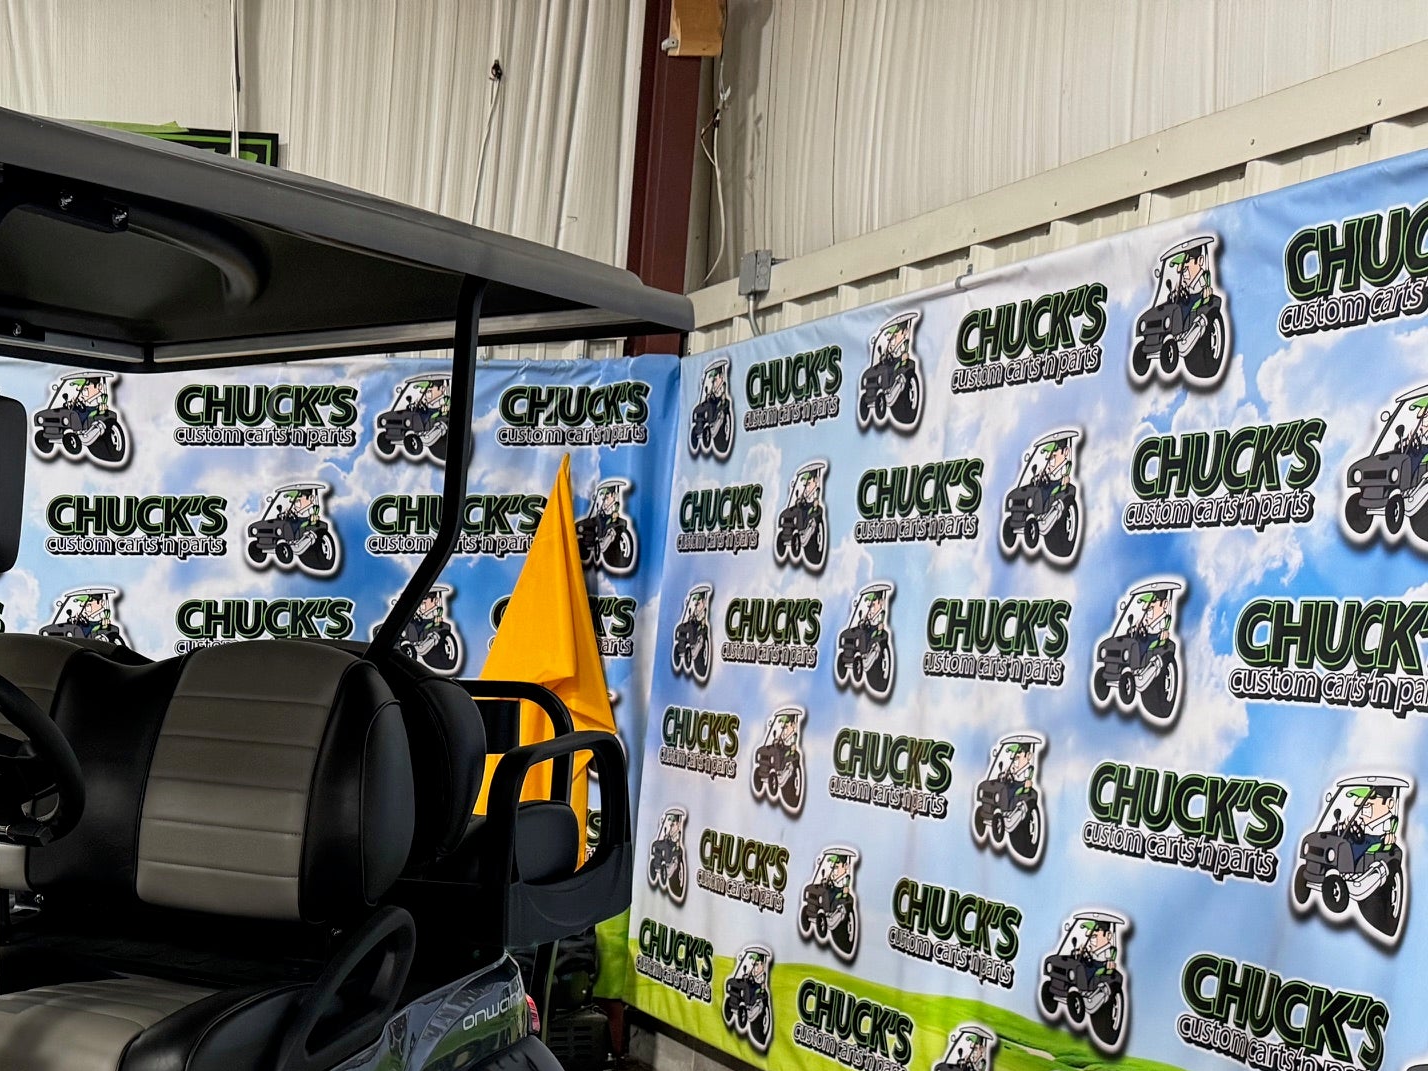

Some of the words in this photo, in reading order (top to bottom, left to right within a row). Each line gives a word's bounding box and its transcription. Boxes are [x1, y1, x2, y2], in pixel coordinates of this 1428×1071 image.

[957, 283, 1109, 364] CHUCK'S
[1279, 293, 1368, 333] custom
[745, 345, 843, 407] CHUCK'S
[951, 362, 1004, 394] custom
[1056, 343, 1100, 383] parts
[175, 384, 357, 427] CHUCK'S
[499, 381, 650, 427] CHUCK'S
[174, 426, 242, 445] custom
[307, 426, 353, 449] parts
[1132, 420, 1328, 498] CHUCK'S
[680, 483, 763, 531] CHUCK'S
[859, 457, 985, 518] CHUCK'S
[1124, 499, 1192, 530] custom
[1255, 489, 1311, 529] parts
[46, 495, 228, 536] CHUCK'S
[854, 519, 897, 542] custom
[939, 512, 976, 544] parts
[46, 535, 113, 554] custom
[178, 536, 223, 558] parts
[496, 534, 533, 556] part
[176, 599, 354, 639] CHUCK'S
[725, 597, 822, 645] CHUCK'S
[928, 597, 1071, 658] CHUCK'S
[599, 637, 632, 655] arts
[922, 651, 973, 677] custom
[1021, 657, 1062, 687] parts
[1229, 667, 1318, 698] custom
[663, 708, 740, 758] CHUCK'S
[833, 727, 954, 793] CHUCK'S
[828, 776, 870, 803] custom
[911, 790, 946, 817] parts
[1088, 765, 1288, 850] CHUCK'S
[698, 828, 790, 892] CHUCK'S
[1081, 822, 1145, 856] custom
[1213, 844, 1276, 882] parts
[892, 877, 1022, 961] CHUCK'S
[639, 918, 715, 982] CHUCK'S
[793, 1023, 835, 1057] custom
[799, 978, 914, 1064] CHUCK'S
[1177, 1014, 1248, 1059] custom
